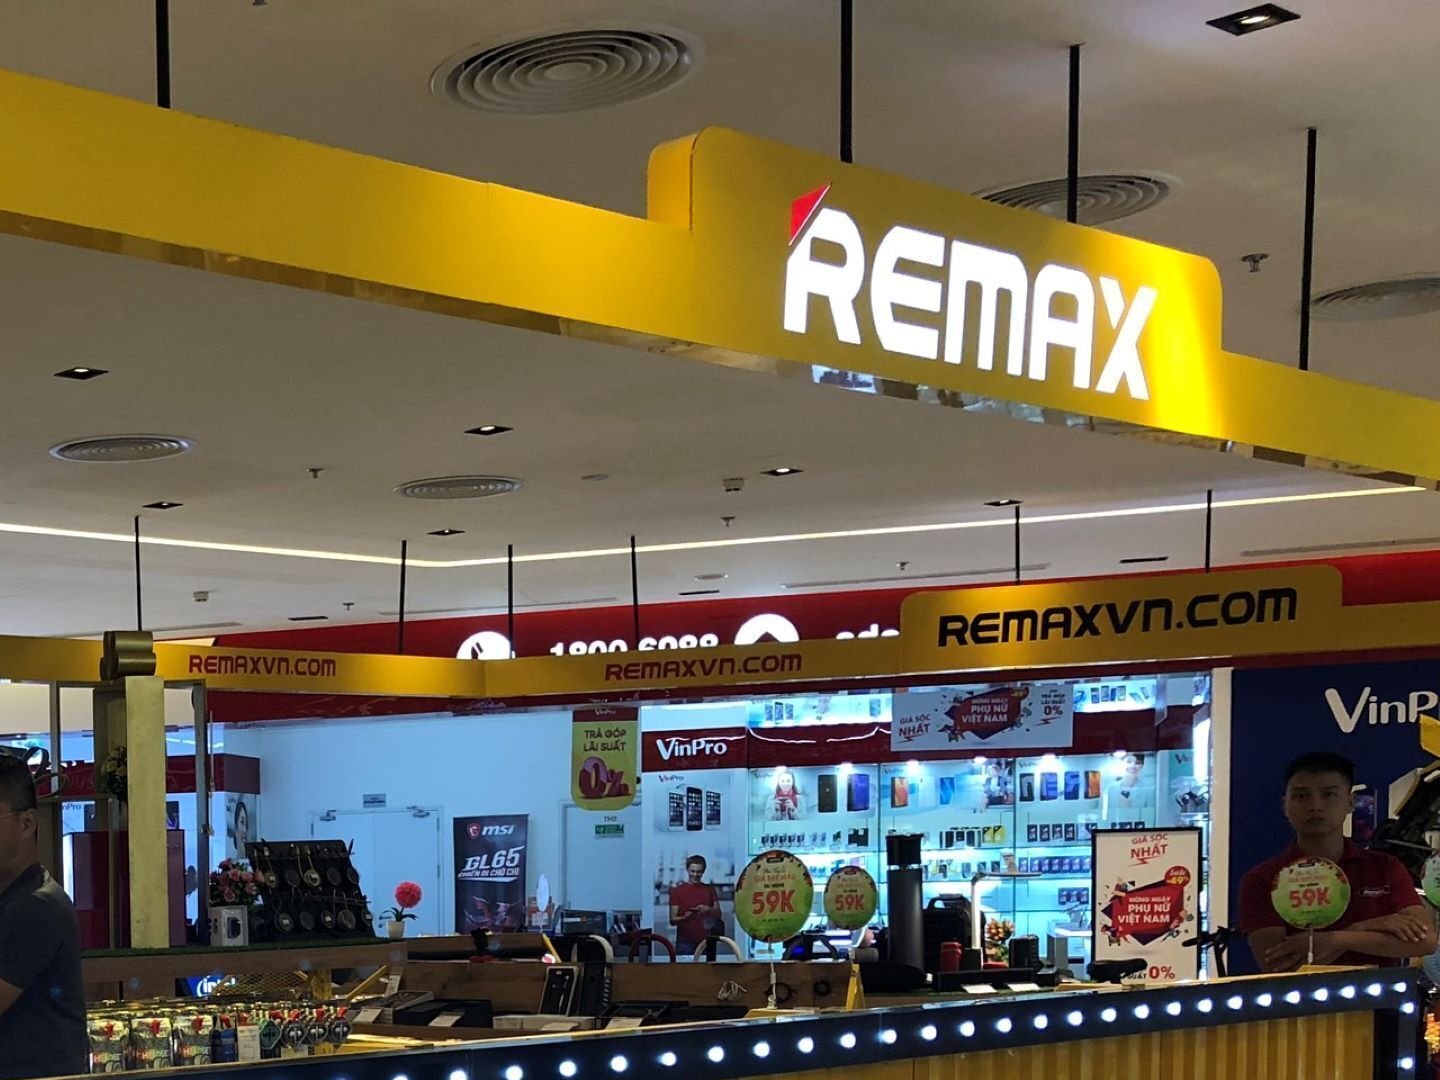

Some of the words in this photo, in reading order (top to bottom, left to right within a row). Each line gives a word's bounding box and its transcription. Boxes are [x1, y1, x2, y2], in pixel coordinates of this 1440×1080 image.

[783, 184, 1158, 400] REMAX
[984, 713, 1008, 722] NAM
[605, 727, 627, 738] GÓP
[601, 739, 626, 751] SUẤT
[656, 738, 728, 760] VinPro
[578, 756, 631, 798] 0%
[481, 824, 515, 836] msi
[1130, 844, 1168, 859] NHẤT
[752, 889, 795, 915] 59K
[835, 894, 865, 912] 59K
[1289, 887, 1332, 908] 59K
[1128, 904, 1151, 914] PHỤ
[1153, 903, 1171, 913] NỮ
[1118, 915, 1139, 926] VIỆT
[1143, 915, 1170, 923] NAM
[1149, 966, 1175, 980] 0%
